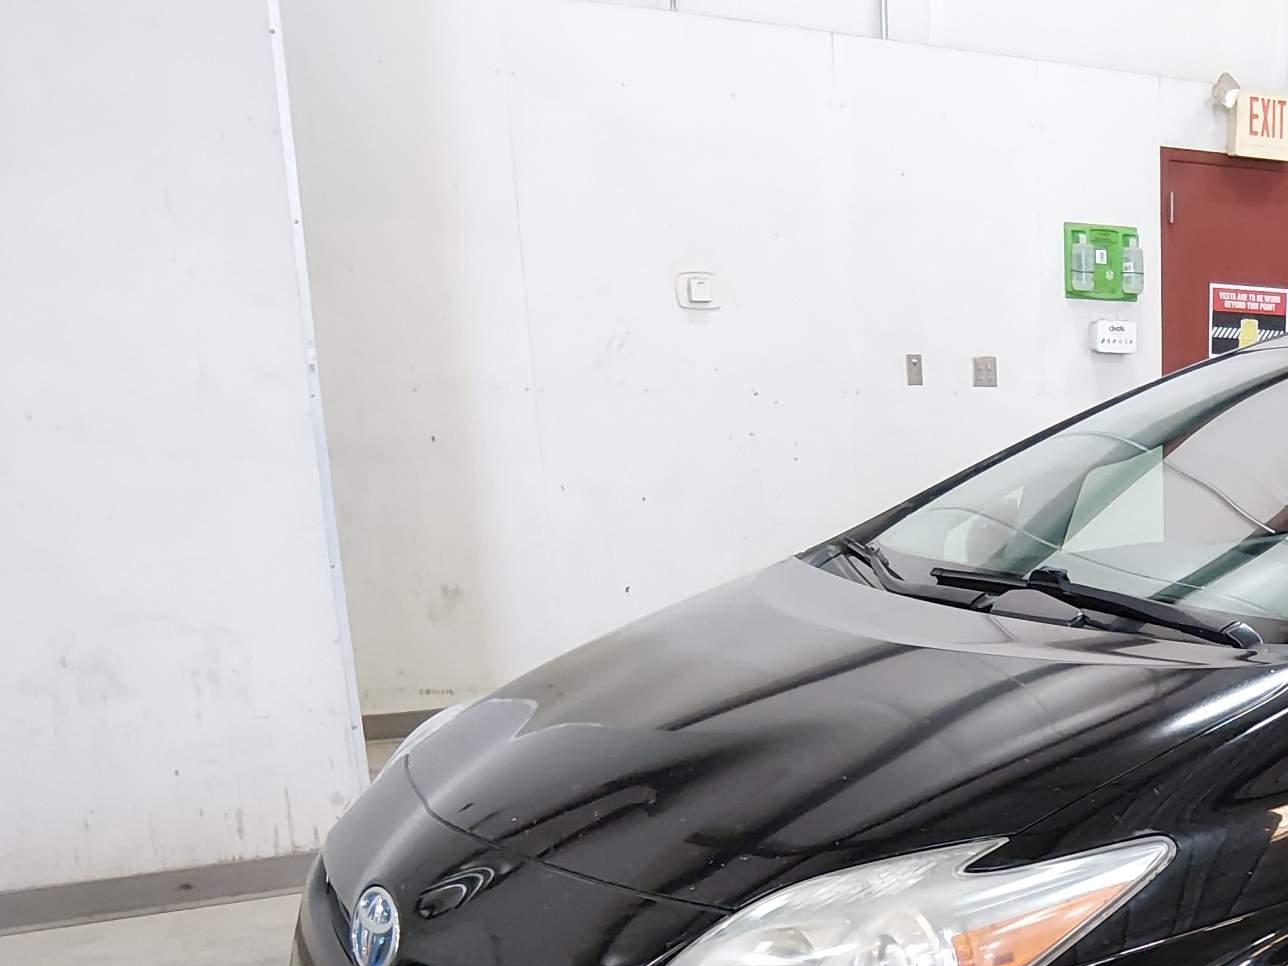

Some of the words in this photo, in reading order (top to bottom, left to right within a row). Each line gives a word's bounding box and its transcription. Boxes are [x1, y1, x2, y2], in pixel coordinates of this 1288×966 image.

[1249, 96, 1287, 139] EXIT
[1237, 292, 1248, 301] ARE
[1249, 293, 1256, 302] TO
[1257, 294, 1264, 303] BE
